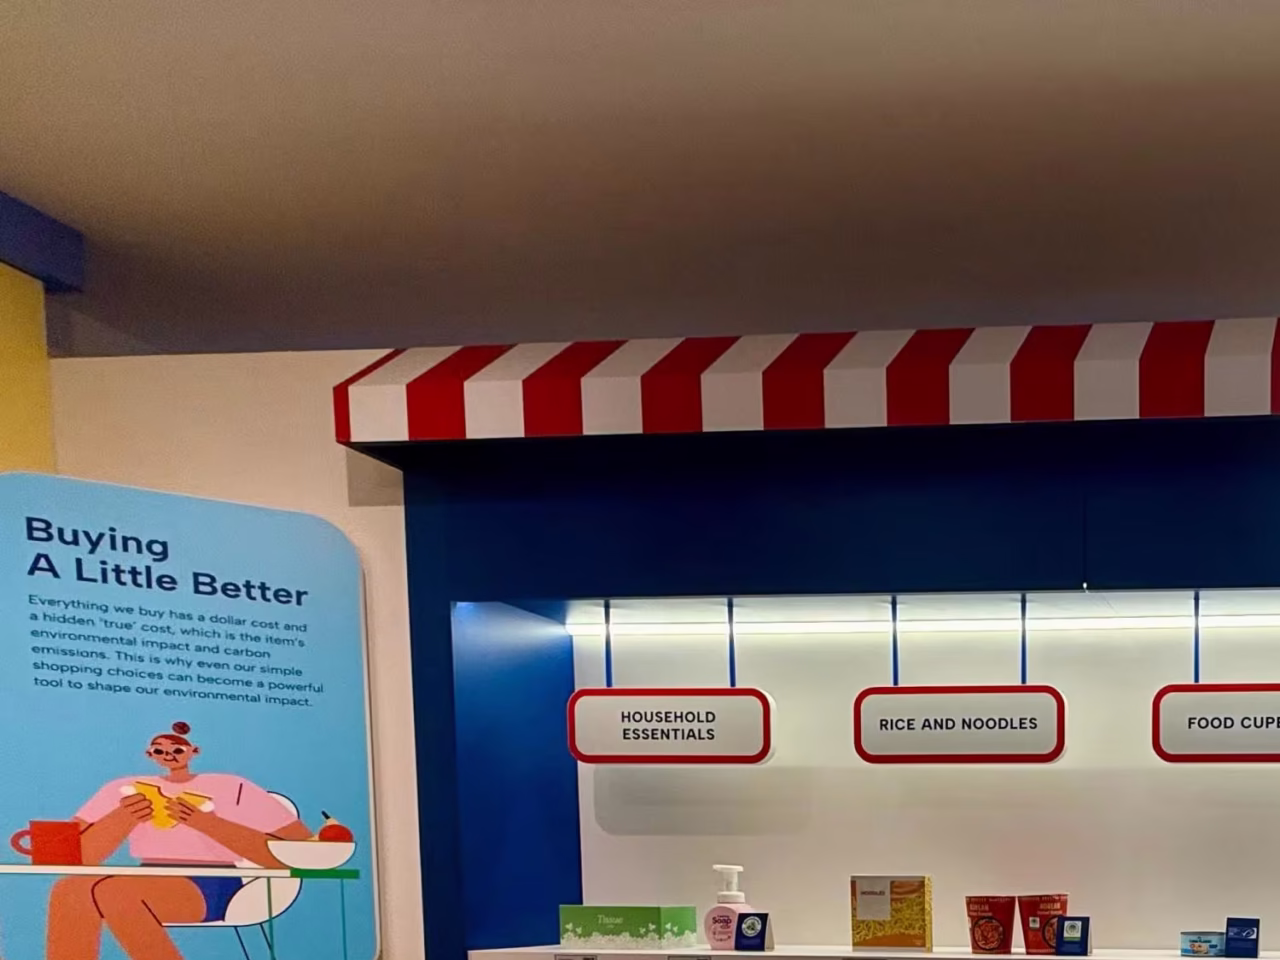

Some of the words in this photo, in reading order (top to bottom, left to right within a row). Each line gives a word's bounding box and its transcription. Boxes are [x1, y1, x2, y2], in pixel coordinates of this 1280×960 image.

[25, 516, 169, 562] Buying
[27, 552, 61, 579] A
[75, 557, 178, 592] Little
[192, 571, 309, 606] Better
[28, 594, 109, 614] Everything
[113, 605, 134, 615] we
[138, 606, 165, 619] buy
[169, 609, 193, 620] has
[197, 614, 206, 622] a
[209, 614, 247, 626] dollar
[251, 620, 280, 630] cost
[284, 623, 308, 633] and
[29, 613, 38, 621] a
[43, 612, 95, 627] hidden
[140, 623, 175, 635] cost,
[180, 626, 221, 639] which
[225, 630, 236, 640] is
[240, 632, 261, 643] the
[265, 634, 305, 647] item's
[30, 629, 137, 646] environmental
[141, 639, 190, 651] impact
[194, 645, 220, 654] and
[224, 646, 271, 658] carbon
[31, 645, 111, 660] emissions.
[115, 650, 145, 663] This
[149, 653, 161, 664] is
[165, 656, 193, 669] why
[197, 660, 230, 670] even
[233, 662, 256, 672] our
[260, 664, 303, 677] simple
[33, 660, 103, 677] shopping
[107, 666, 163, 680] choices
[167, 673, 193, 682] can
[197, 674, 253, 687] become
[256, 680, 265, 688] a
[268, 681, 324, 693] powerful
[34, 677, 63, 687] tool
[67, 680, 83, 690] to
[87, 681, 131, 693] shape
[135, 685, 160, 695] our
[163, 688, 261, 703] environmental
[265, 695, 313, 707] impact.
[621, 711, 716, 723] HOUSEHOLD
[879, 718, 916, 731] RICE
[921, 718, 956, 731] AND
[961, 717, 1038, 730] NOODLES
[1188, 716, 1235, 730] FOOD
[622, 728, 715, 741] ESSENTIALS
[712, 916, 732, 927] Soap
